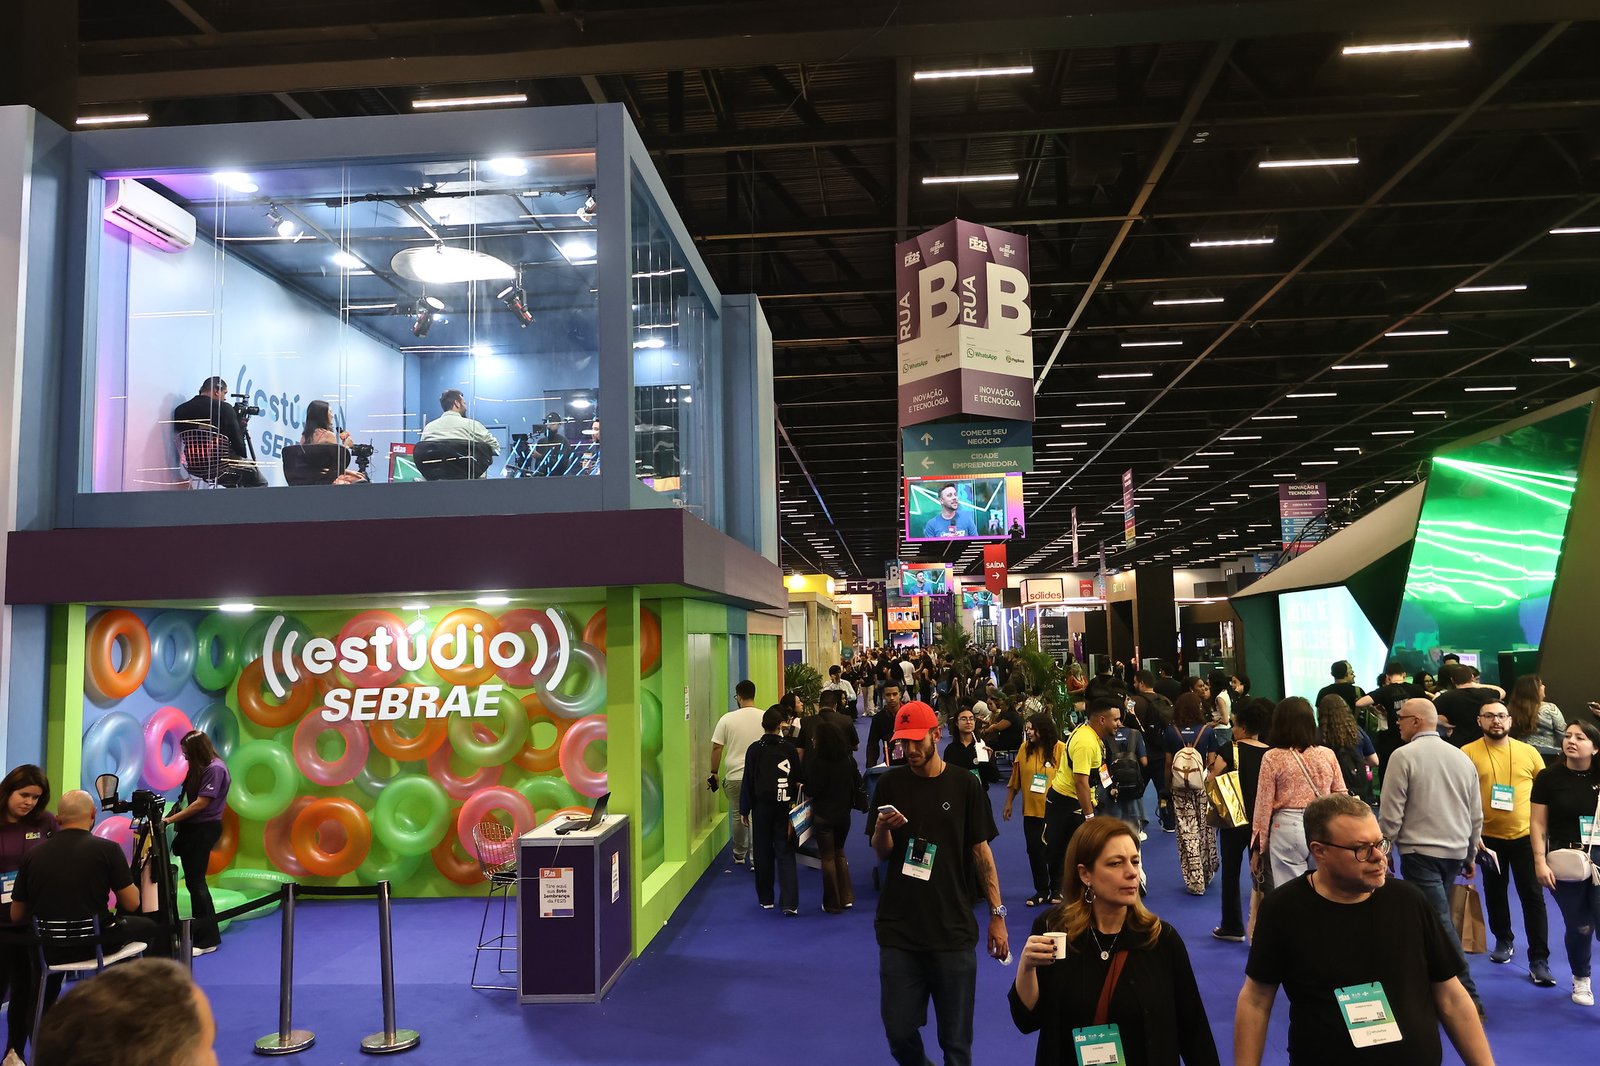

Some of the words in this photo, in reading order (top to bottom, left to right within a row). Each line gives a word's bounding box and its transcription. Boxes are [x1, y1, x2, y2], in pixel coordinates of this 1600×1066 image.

[969, 237, 988, 252] FE25
[919, 260, 960, 335] B
[963, 275, 977, 324] RUA
[986, 262, 1032, 335] B
[900, 291, 911, 341] RUA
[975, 351, 998, 361] WhatsApp
[909, 359, 929, 370] WhatsApp
[912, 389, 943, 403] INOVAÇÃO
[979, 386, 1014, 398] INOVAÇÃO
[913, 396, 950, 411] TECNOLOGIA
[974, 394, 979, 402] E
[980, 396, 1021, 408] TECNOLOGIA
[960, 429, 992, 437] COMECE
[993, 428, 1008, 436] SEU
[967, 436, 1002, 445] NEGÓCIO
[971, 452, 999, 460] CIDADE
[952, 460, 1018, 470] EMPREENDEDORA
[986, 560, 1005, 569] SAÍDA
[1029, 591, 1062, 600] sólides
[302, 616, 525, 675] estúdio
[321, 684, 503, 722] SEBRAE
[777, 758, 792, 802] FILA
